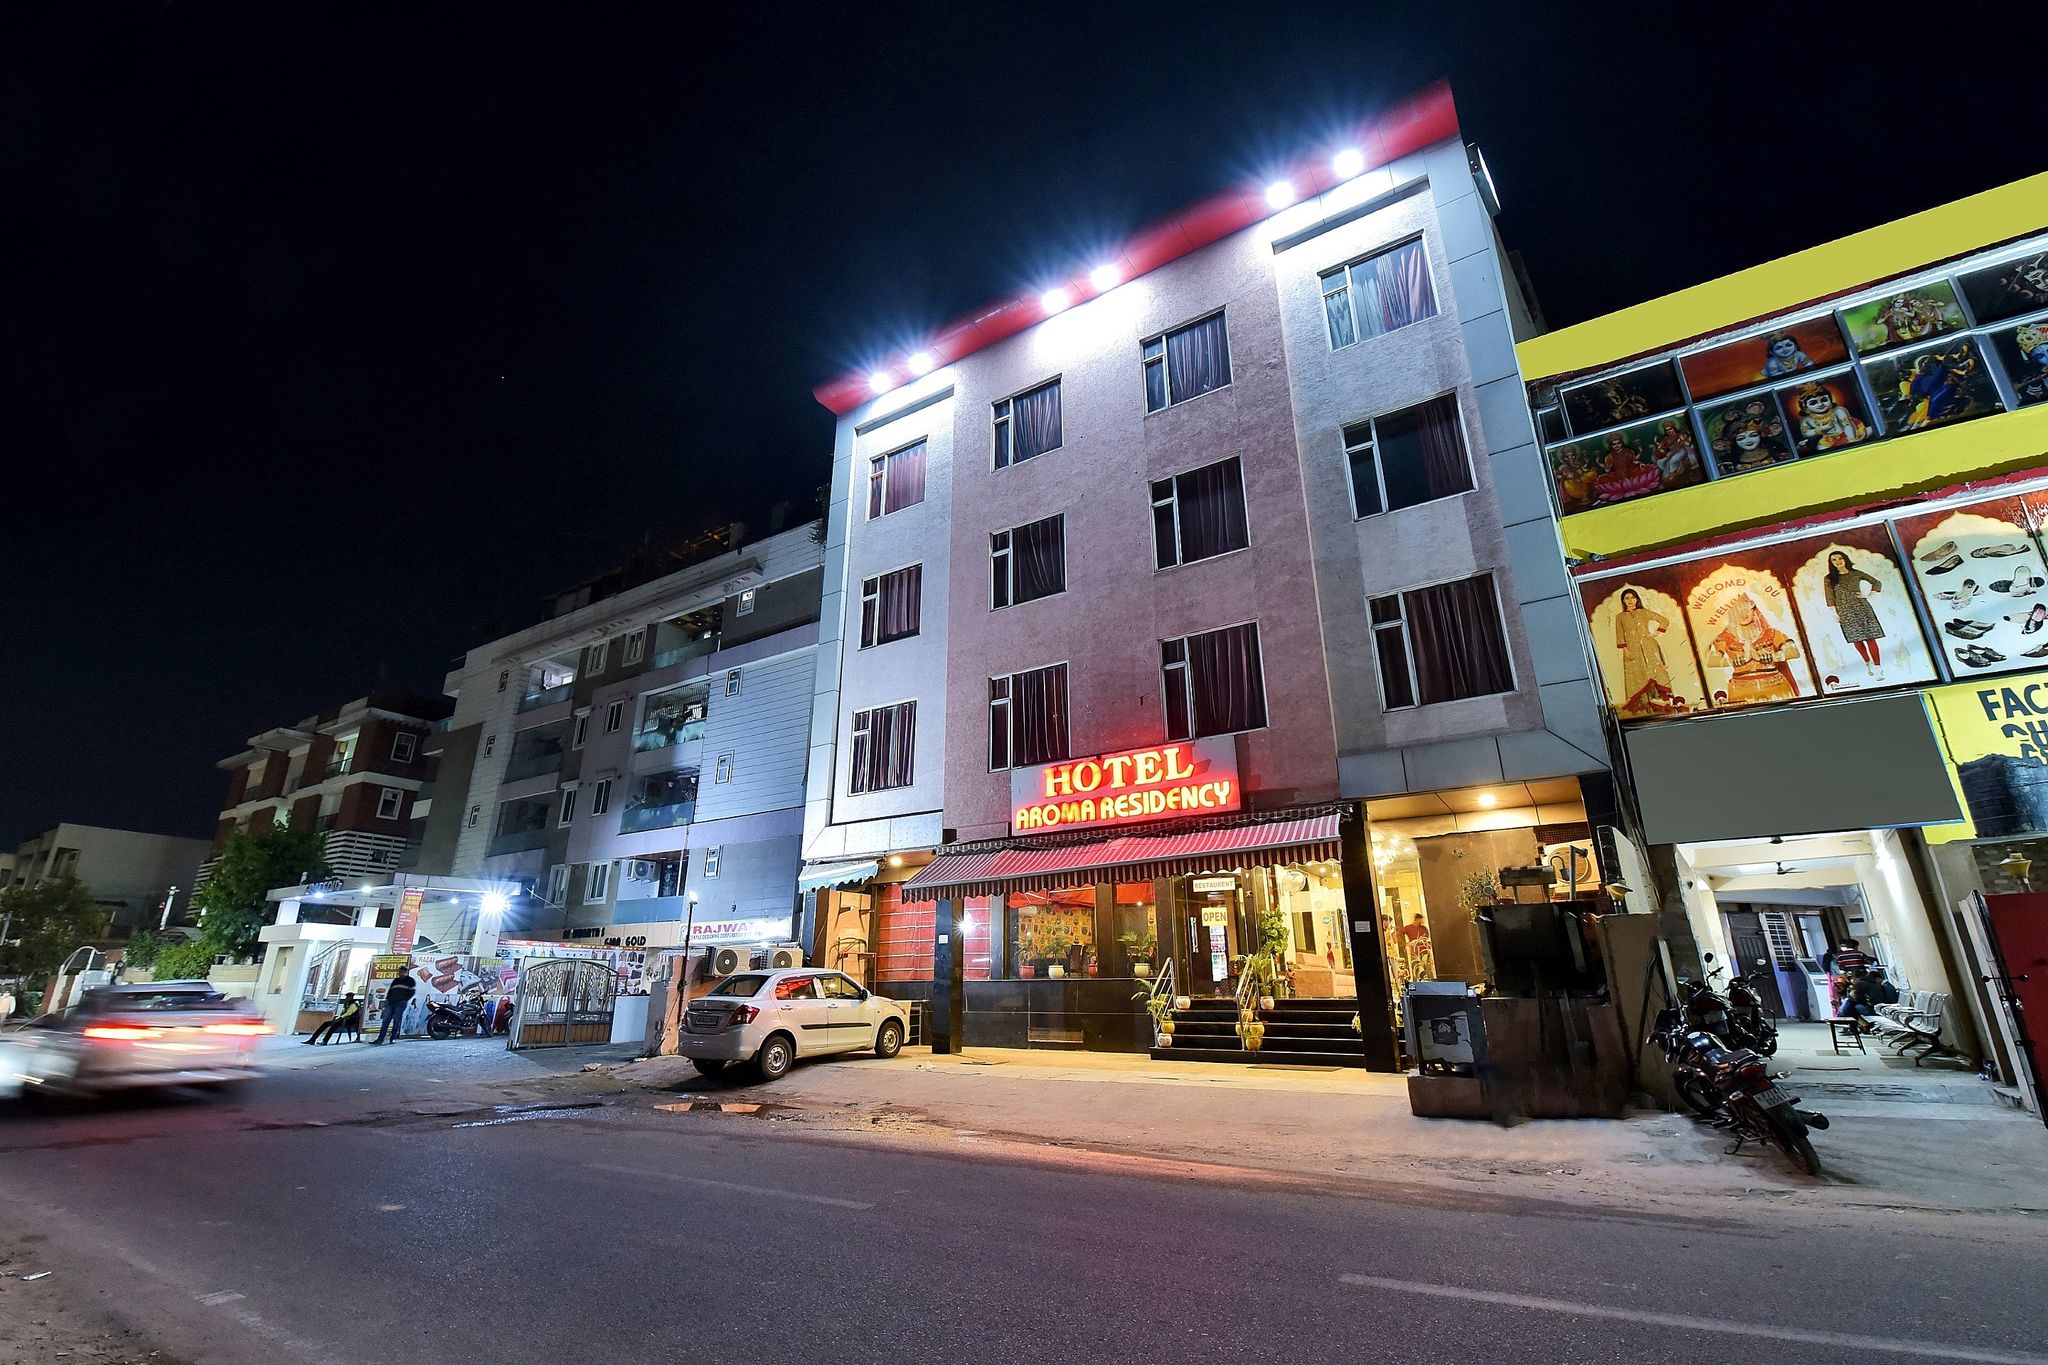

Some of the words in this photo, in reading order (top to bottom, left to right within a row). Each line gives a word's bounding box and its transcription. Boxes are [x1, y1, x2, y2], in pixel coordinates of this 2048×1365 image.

[1043, 747, 1195, 798] HOTEL
[1015, 798, 1096, 830] AROMA
[1100, 780, 1231, 820] RESIDENCY
[1203, 911, 1227, 922] OPEN
[692, 922, 752, 935] RAJWA
[625, 935, 647, 947] GOLD
